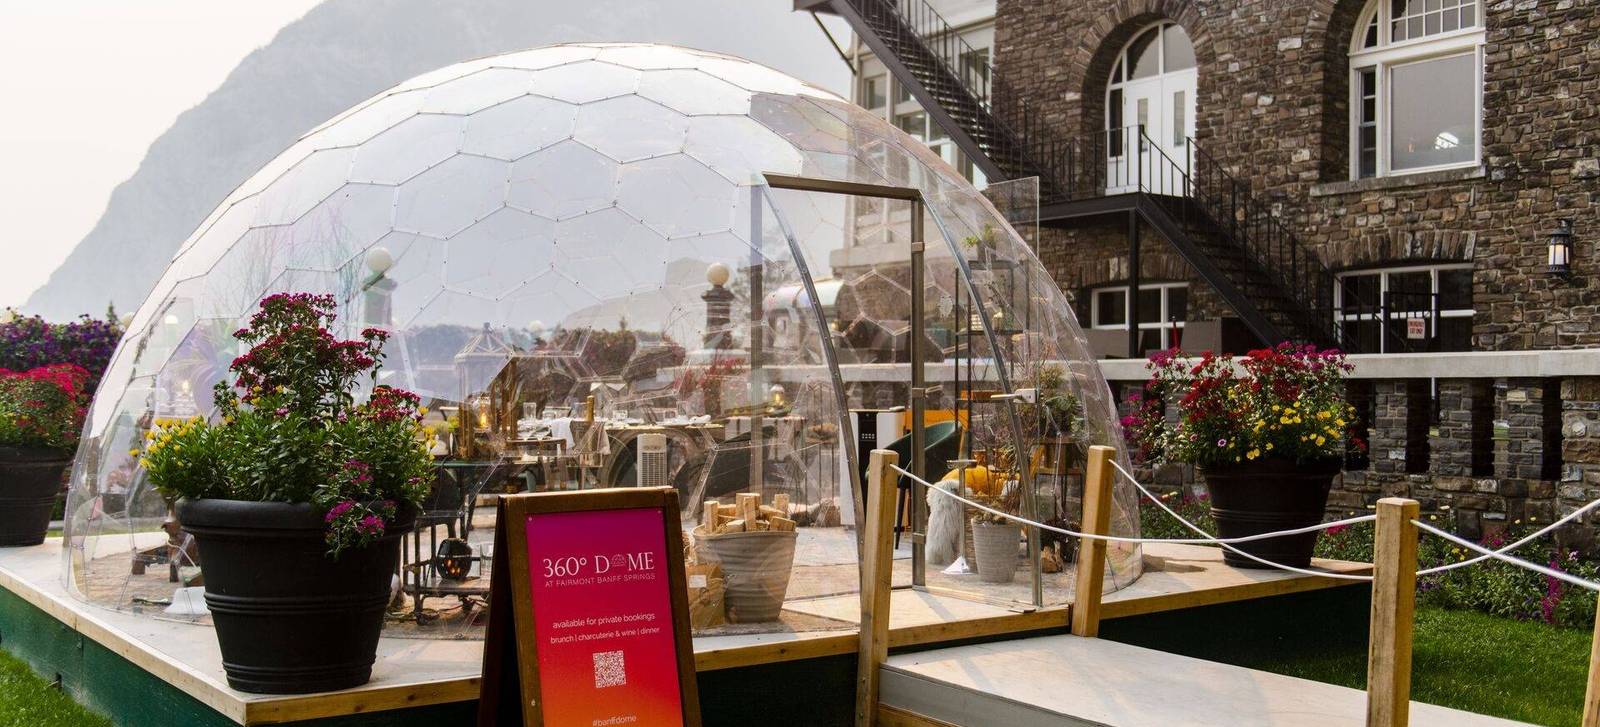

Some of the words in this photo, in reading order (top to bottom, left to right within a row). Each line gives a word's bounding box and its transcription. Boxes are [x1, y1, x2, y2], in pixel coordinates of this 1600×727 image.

[544, 580, 553, 588] AT
[555, 577, 596, 588] FAIRMONT
[596, 575, 622, 585] BANFF
[623, 573, 656, 582] SPRINGS
[552, 618, 586, 629] available
[586, 617, 597, 626] for
[597, 615, 623, 626] private
[623, 612, 656, 622] bookings
[550, 634, 574, 645] brunch
[578, 631, 615, 642] charcuterie
[615, 630, 621, 638] &
[621, 628, 637, 637] wine
[640, 626, 660, 635] dinner
[592, 714, 637, 727] #banffdome
